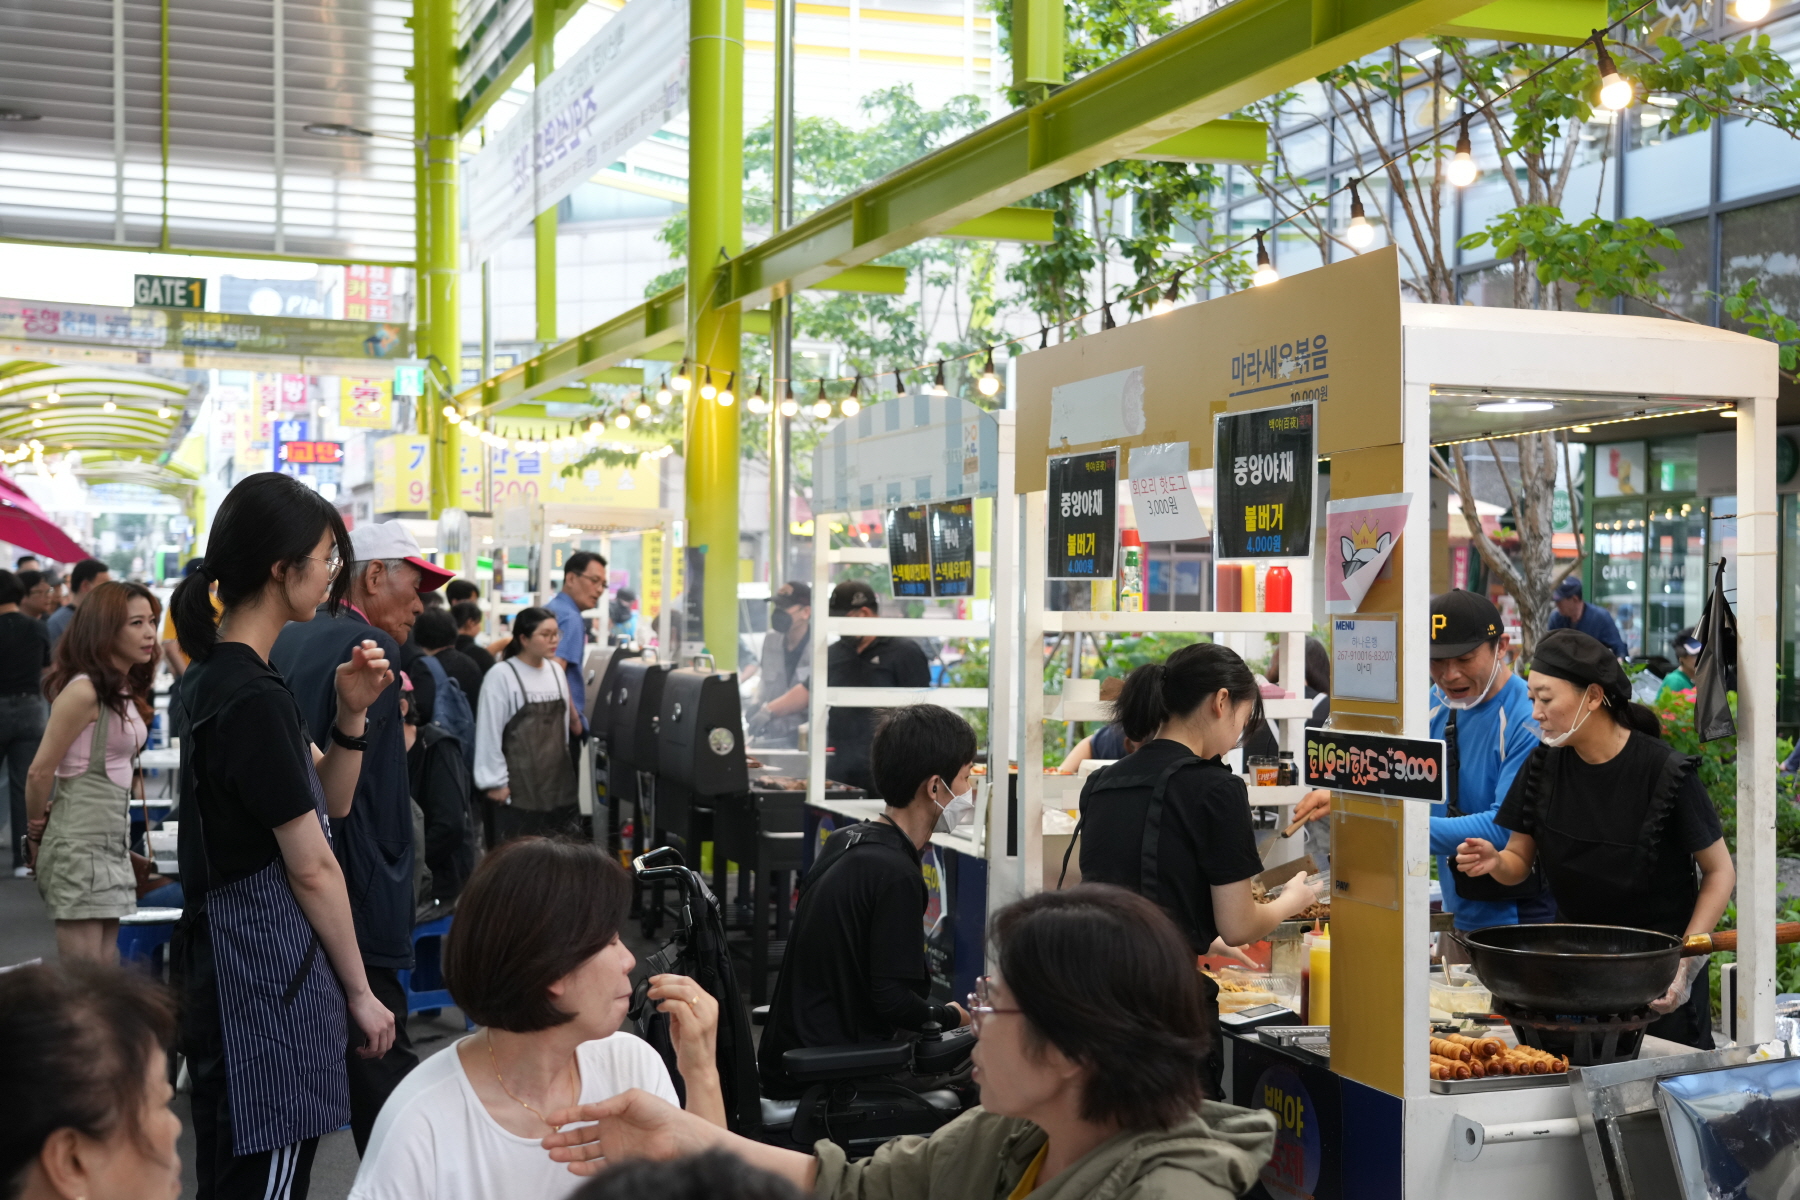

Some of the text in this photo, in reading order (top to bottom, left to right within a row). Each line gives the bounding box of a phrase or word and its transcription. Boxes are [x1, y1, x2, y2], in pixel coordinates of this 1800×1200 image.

[135, 277, 200, 307] GATE 1
[1290, 385, 1328, 404] 10000원
[1234, 451, 1294, 486] 중앙야채
[1132, 475, 1188, 496] 회오리 핫도그
[1061, 489, 1103, 517] 중앙야채
[1147, 496, 1179, 516] 3,000원
[1245, 503, 1284, 532] 불버거
[1067, 533, 1096, 556] 불버거
[1246, 535, 1282, 553] 4,000원
[1602, 565, 1633, 580] CAFE
[1336, 621, 1355, 630] MENU
[1431, 614, 1447, 640] P
[1352, 636, 1378, 648] 하나은행
[1336, 880, 1350, 892] PAY
[1264, 1085, 1304, 1138] 백야
